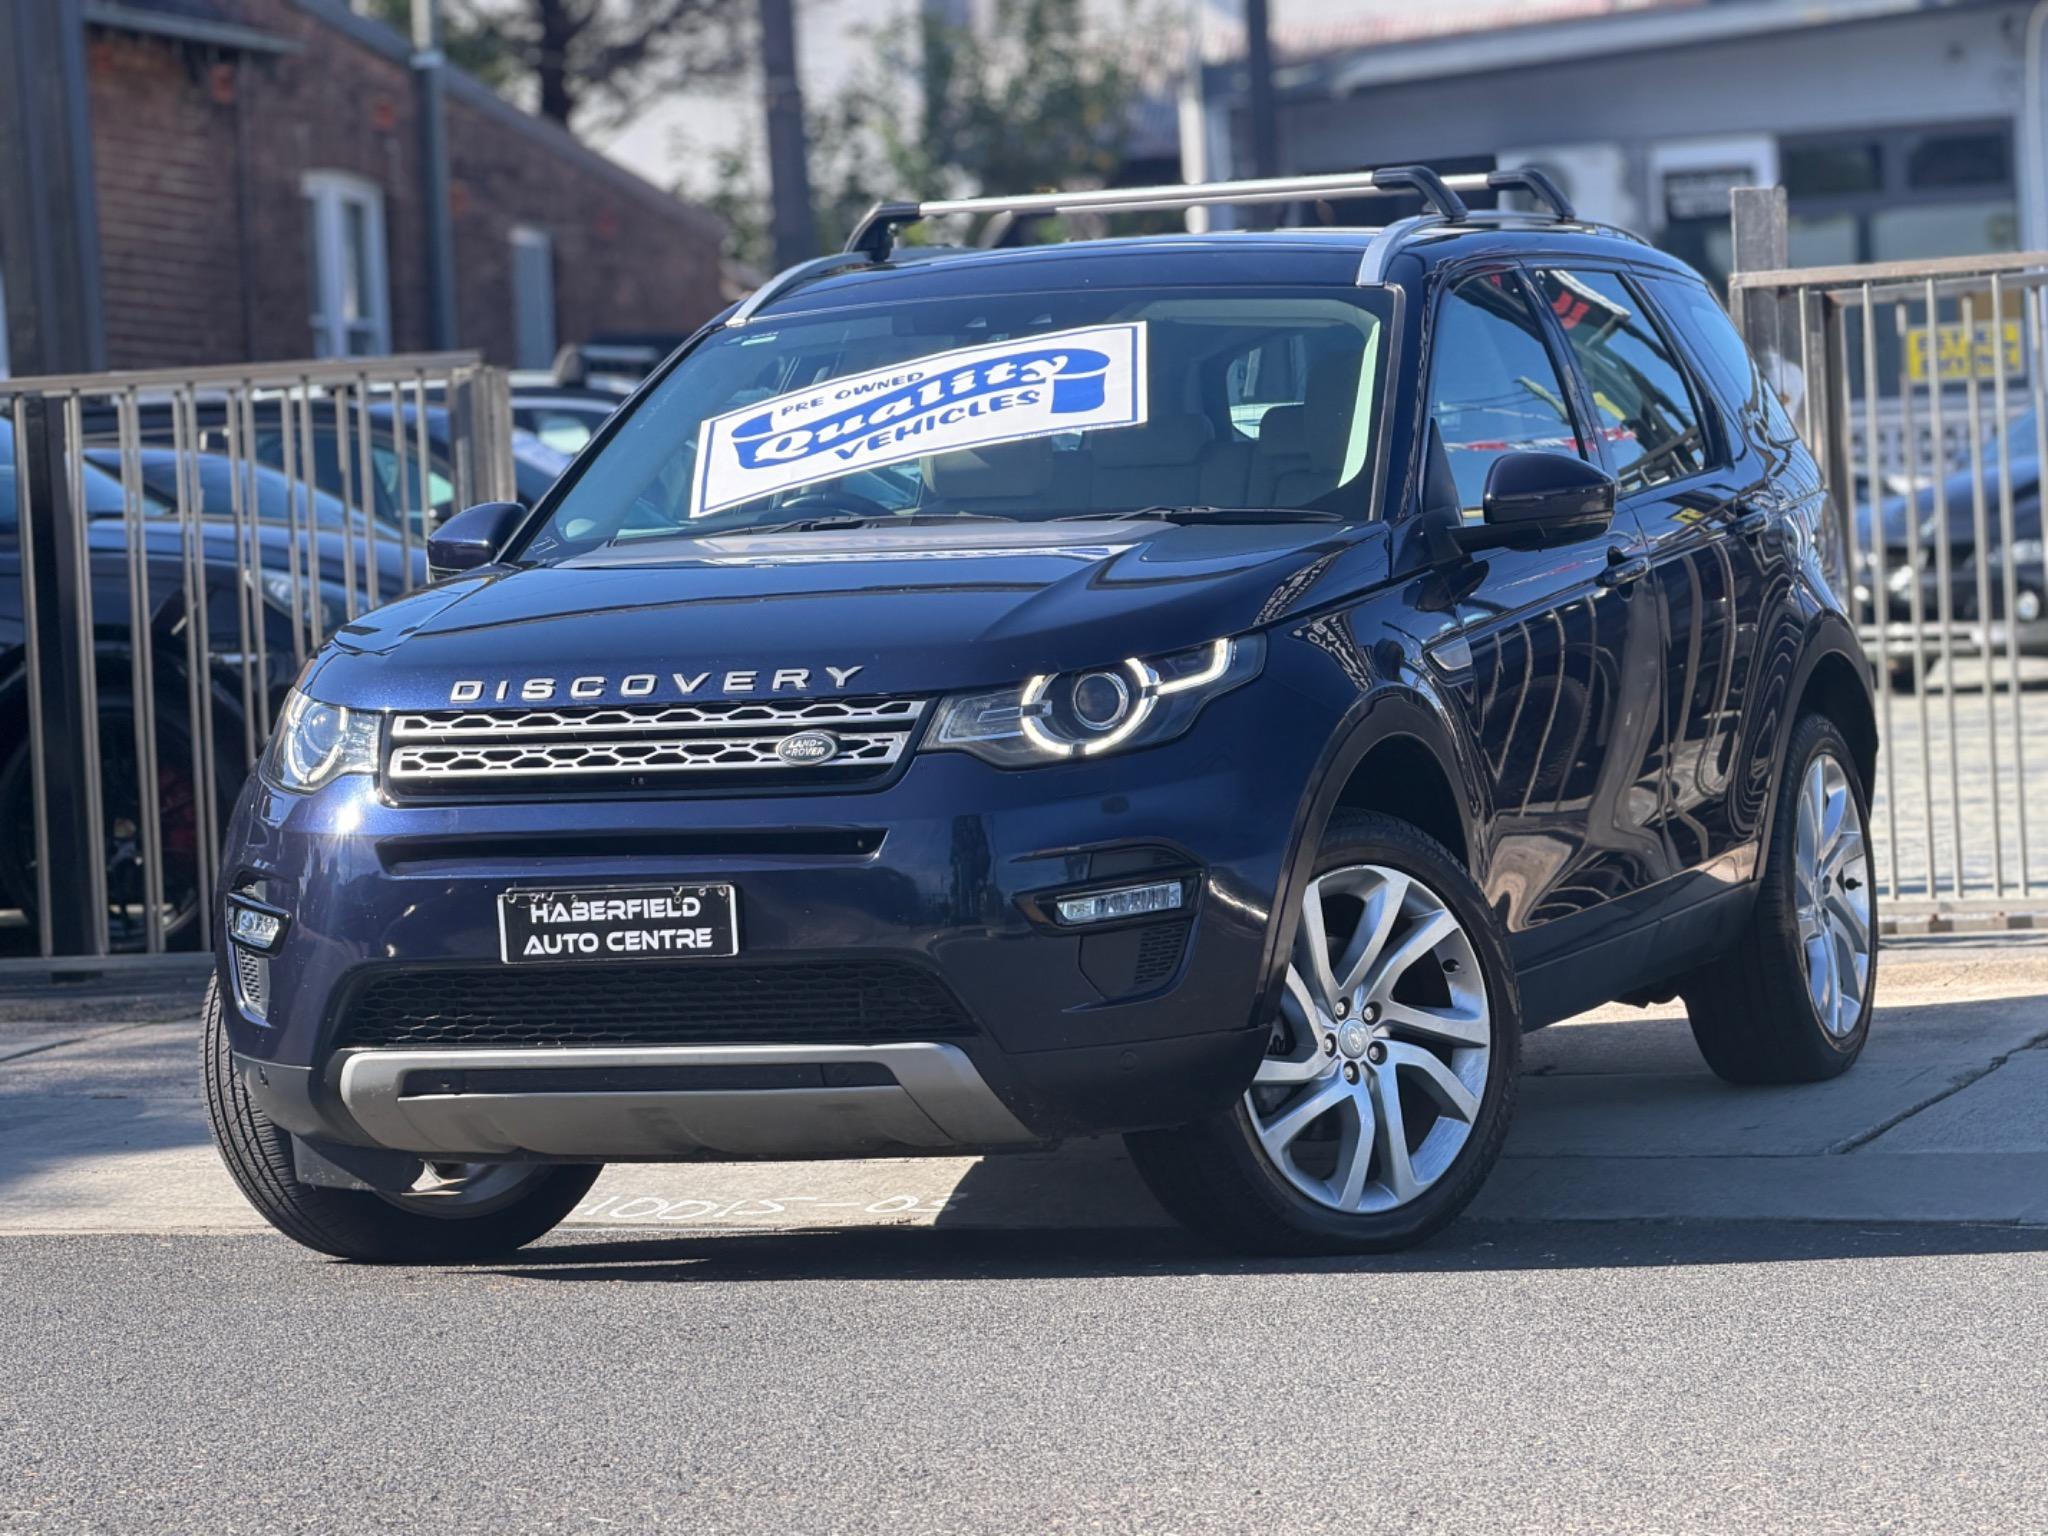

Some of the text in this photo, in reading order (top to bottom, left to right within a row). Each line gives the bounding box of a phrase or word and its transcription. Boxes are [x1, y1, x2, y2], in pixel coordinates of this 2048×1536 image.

[754, 355, 1070, 462] Quality
[781, 372, 925, 417] PRE OWNED
[834, 390, 1041, 460] VEHICLES
[450, 665, 864, 702] DISCOVERY
[530, 896, 701, 924] HABERFIELD
[522, 927, 714, 956] AUTO CENTRE
